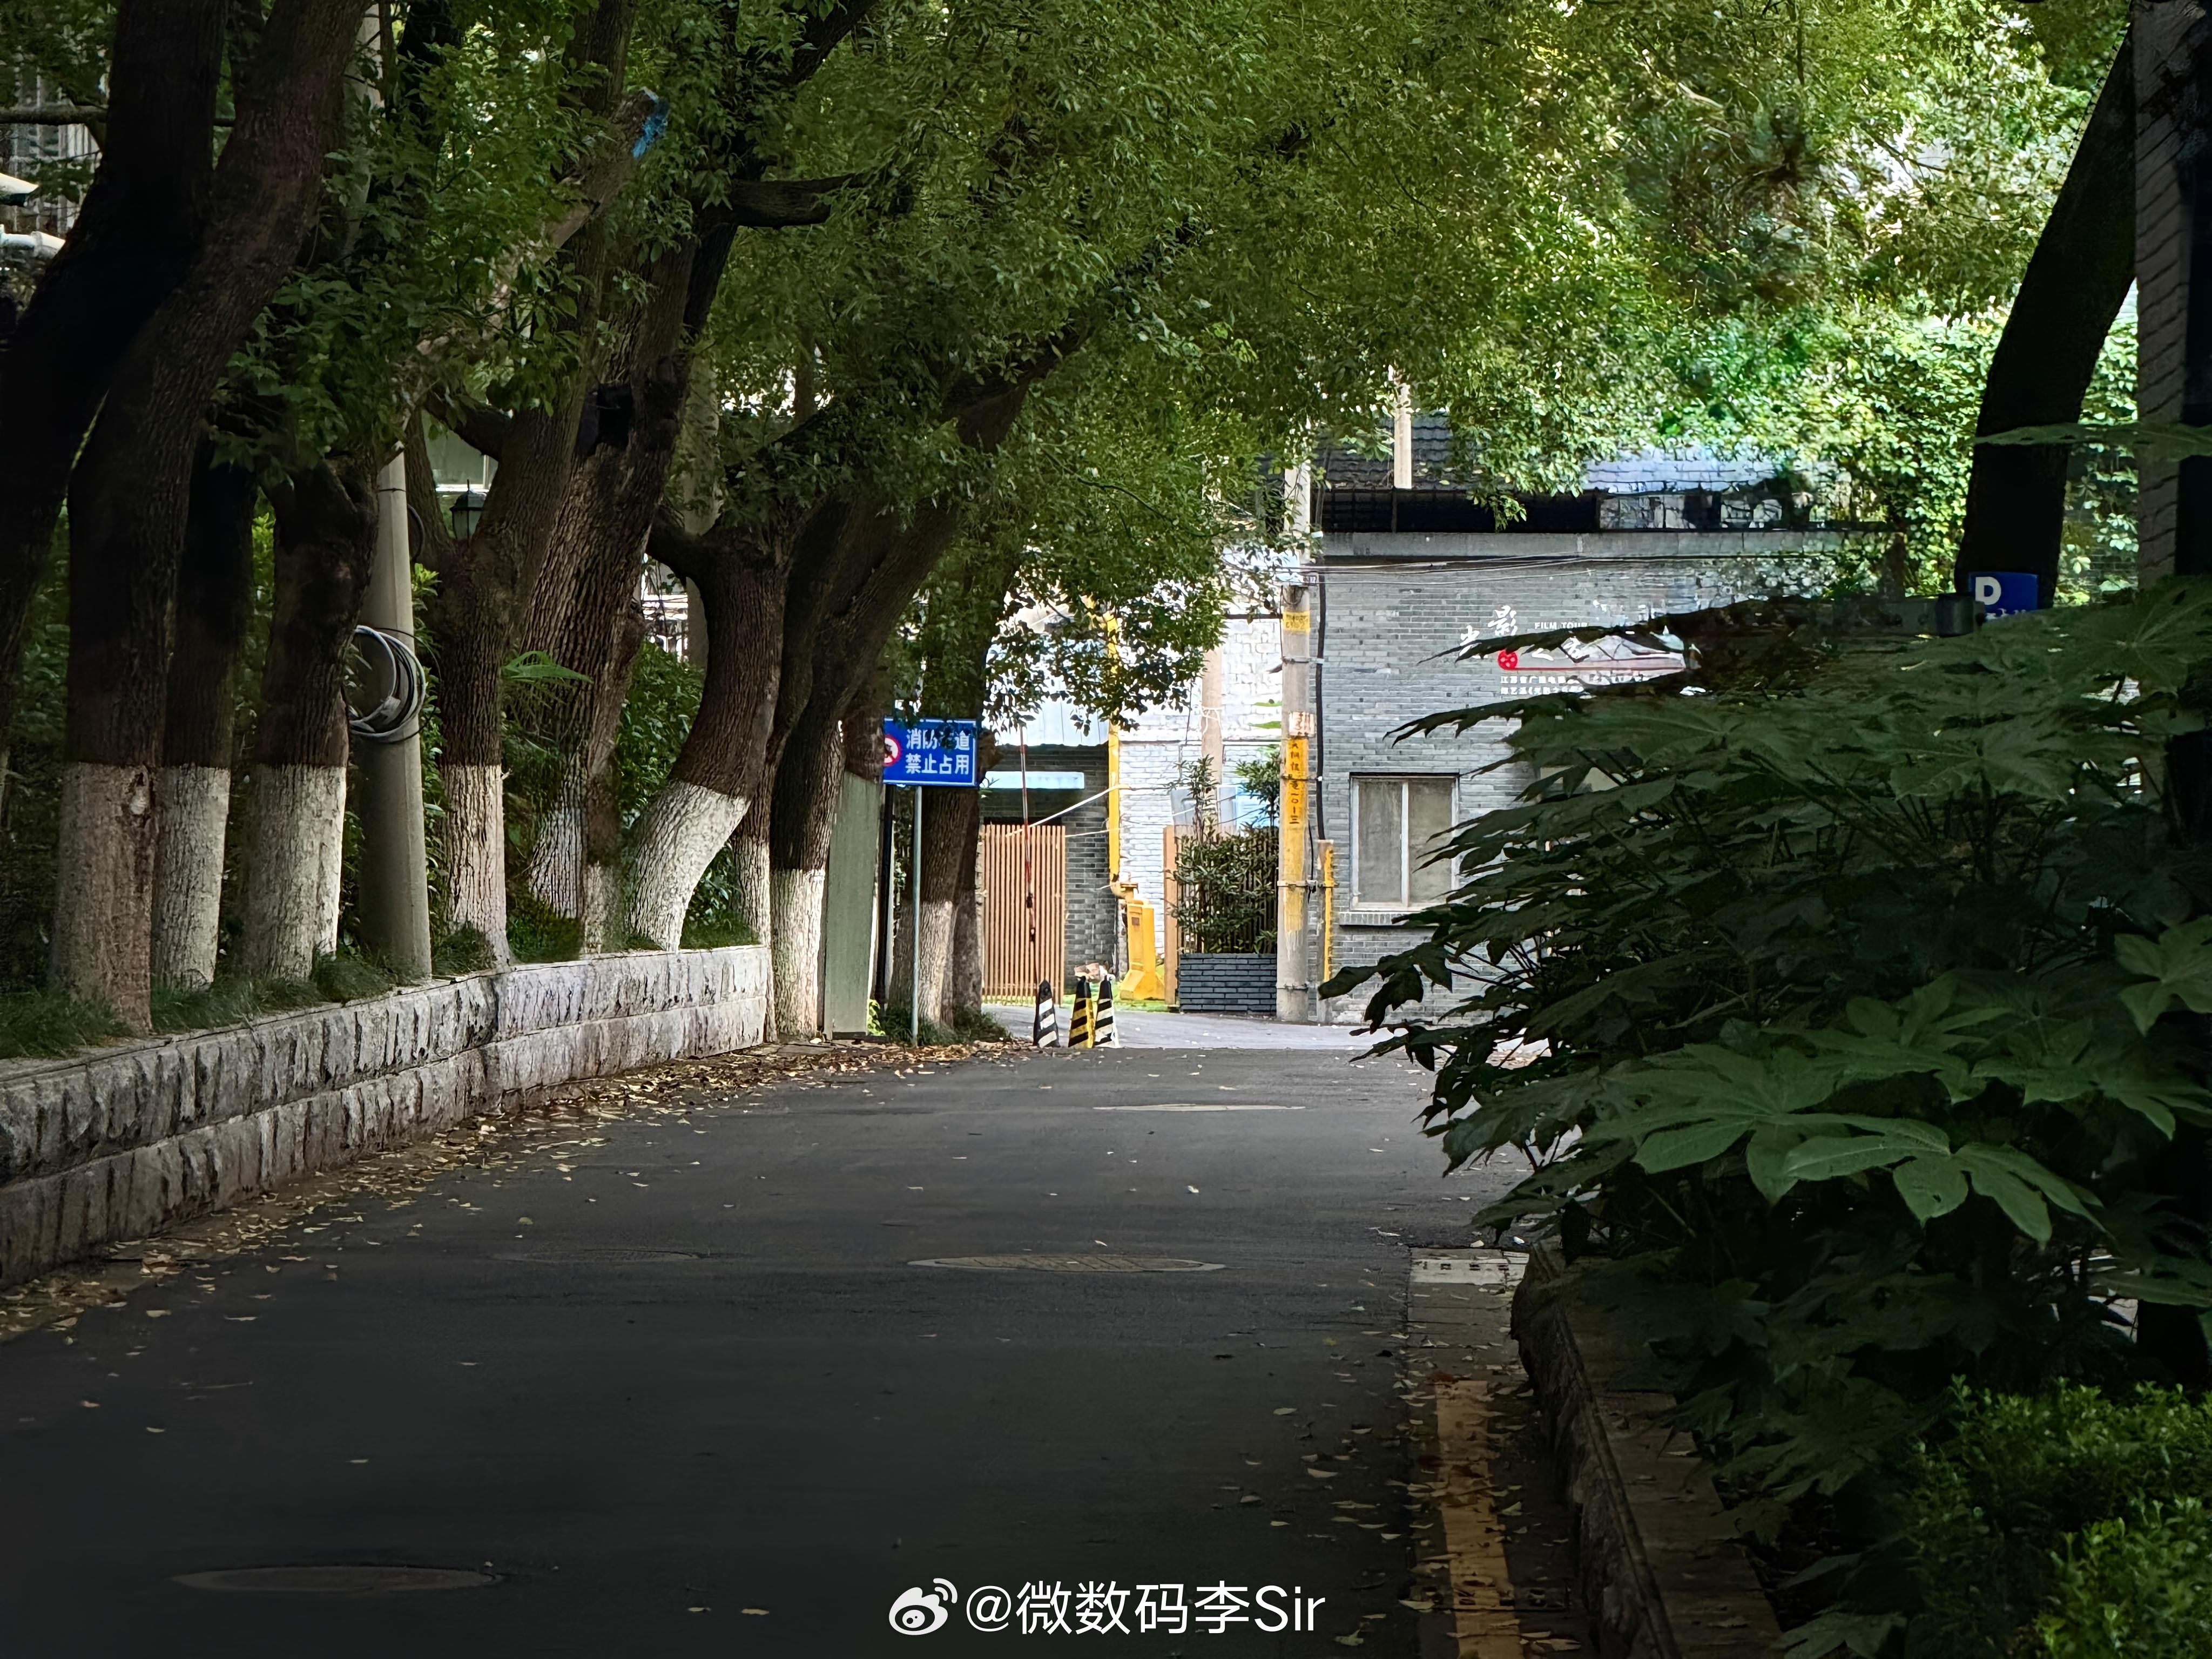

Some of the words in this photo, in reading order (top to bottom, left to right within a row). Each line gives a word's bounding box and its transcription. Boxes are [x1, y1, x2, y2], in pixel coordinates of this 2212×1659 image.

[1534, 622, 1557, 630] FILM
[906, 729, 970, 751] 消防道
[905, 753, 969, 775] 禁止占用
